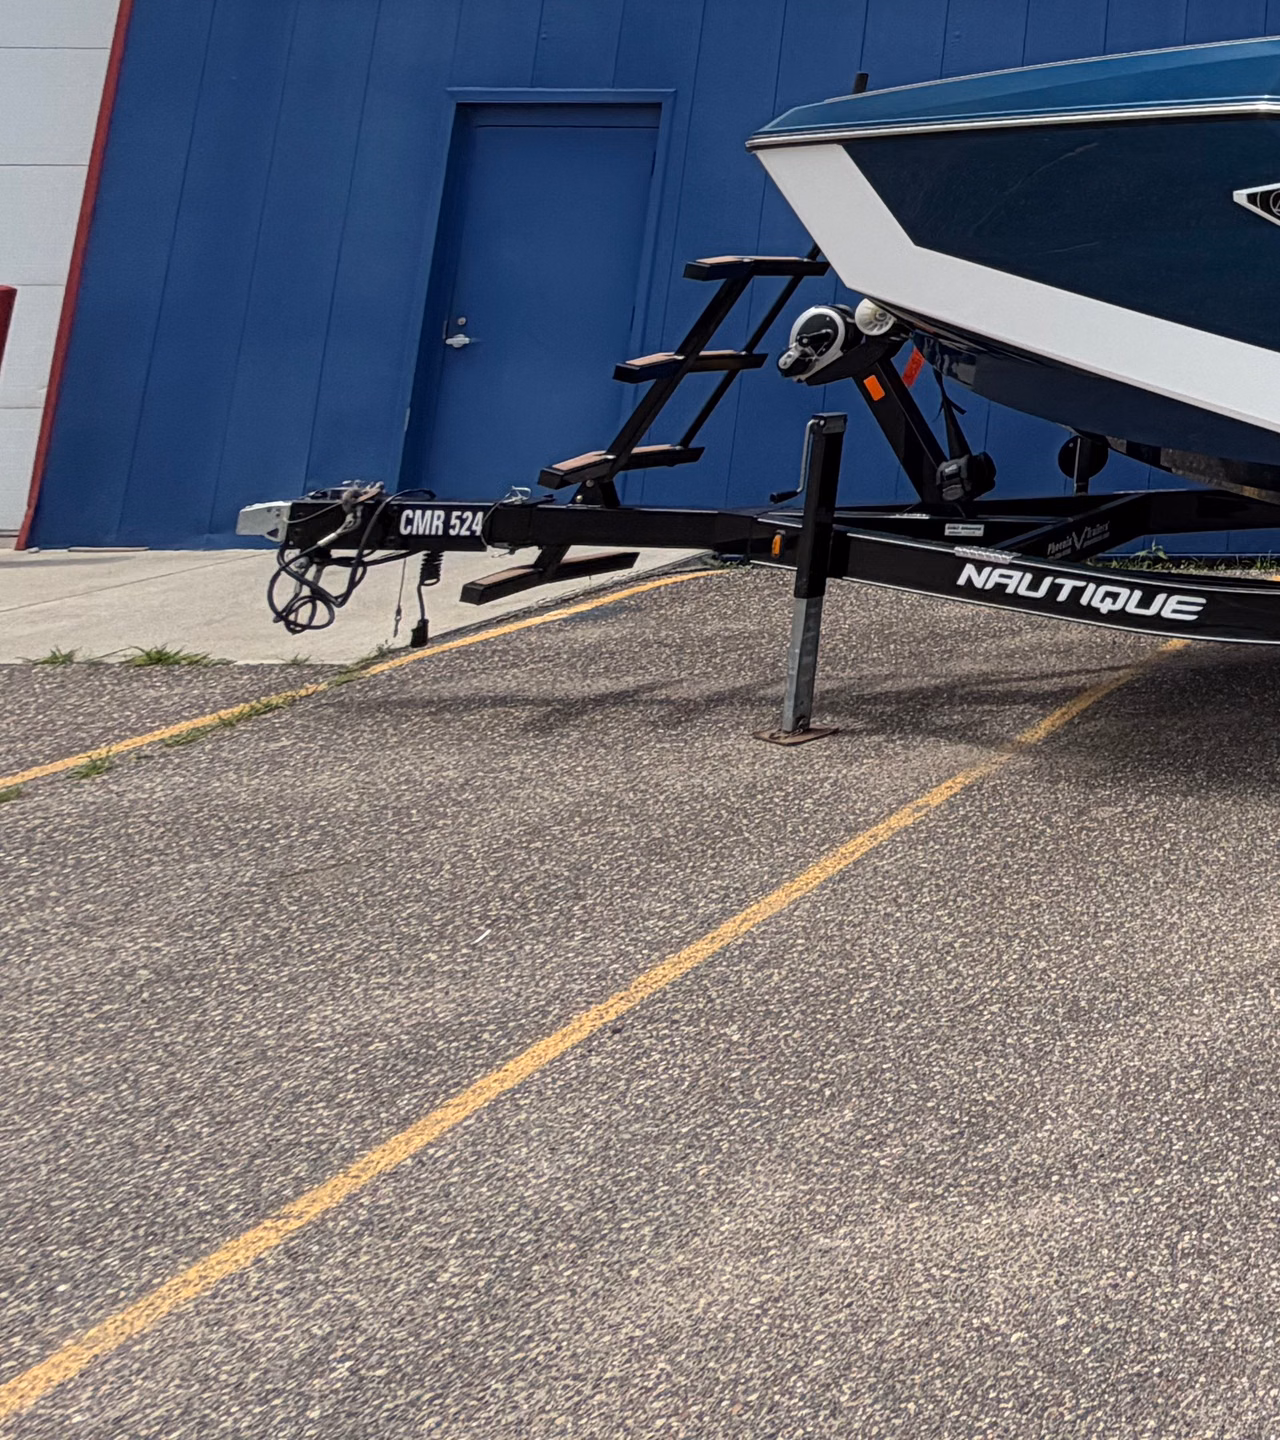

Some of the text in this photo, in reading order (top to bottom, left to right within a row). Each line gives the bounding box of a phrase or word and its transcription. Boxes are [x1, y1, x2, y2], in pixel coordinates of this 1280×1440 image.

[399, 509, 482, 536] CMR 524
[956, 563, 1206, 621] NAUTIQUE
